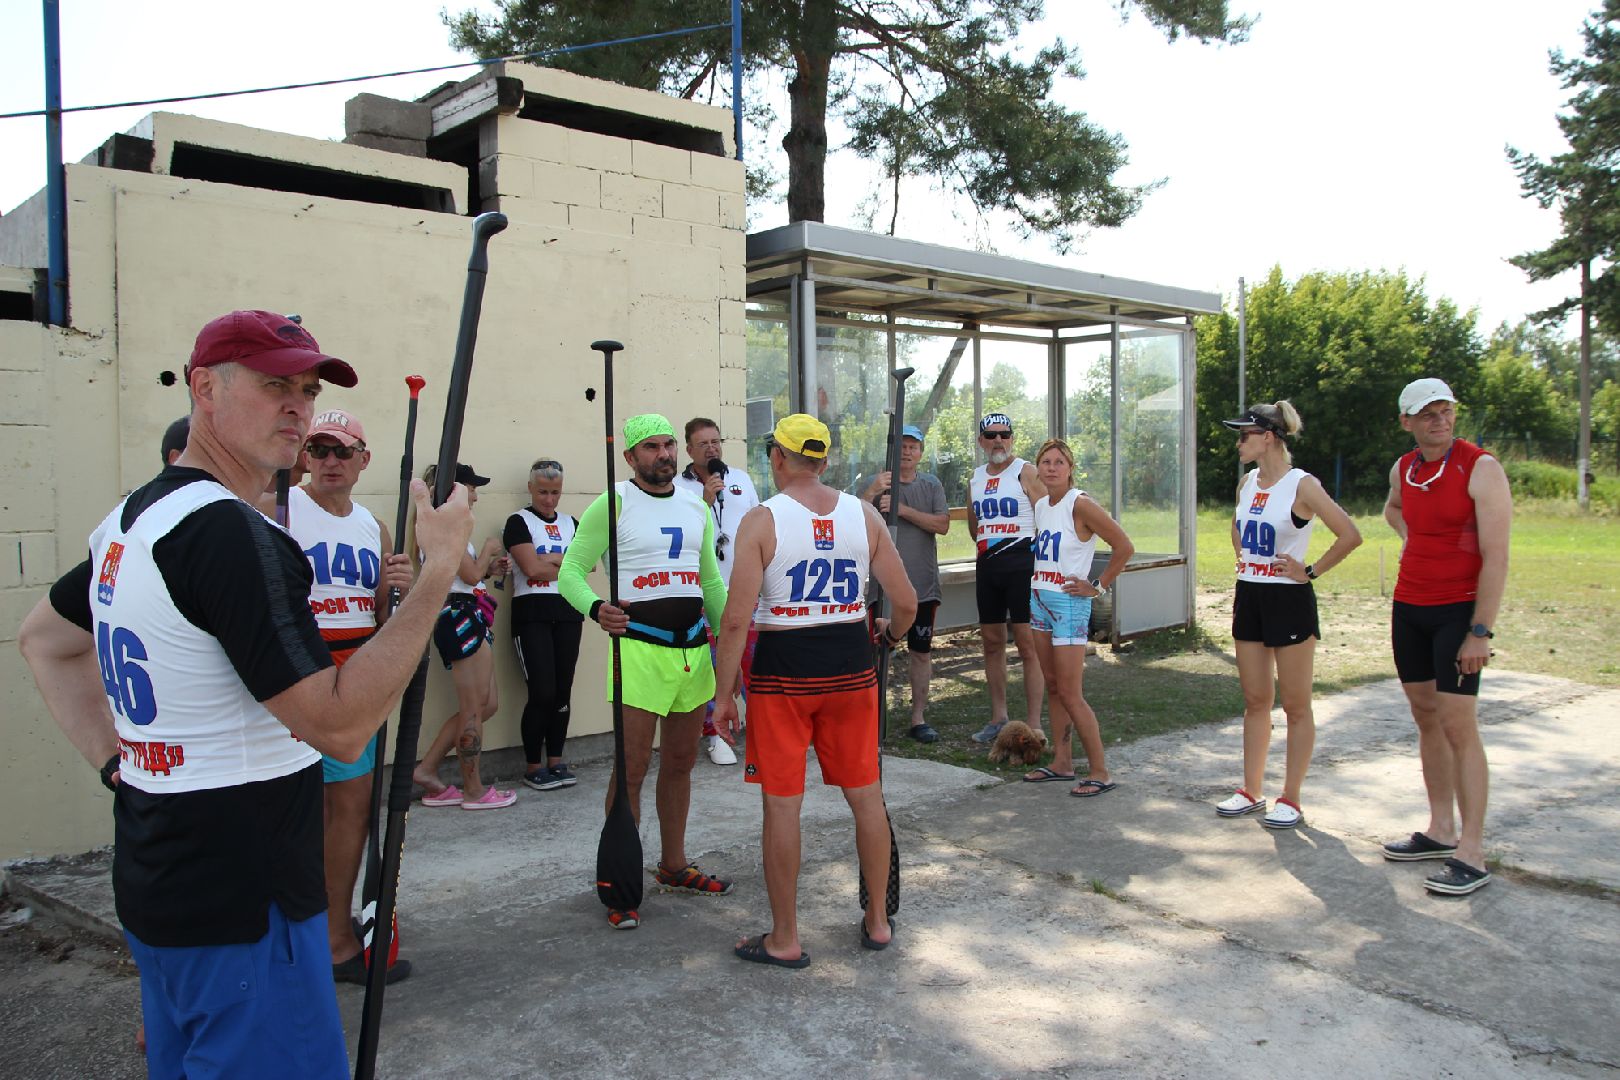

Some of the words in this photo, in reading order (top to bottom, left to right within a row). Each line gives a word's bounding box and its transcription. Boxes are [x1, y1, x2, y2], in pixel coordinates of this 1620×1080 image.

[315, 412, 349, 427] NIKE
[660, 527, 683, 559] 7
[304, 541, 380, 590] 140
[632, 571, 671, 590] ФСК
[785, 558, 860, 604] 125
[97, 621, 157, 725] 46
